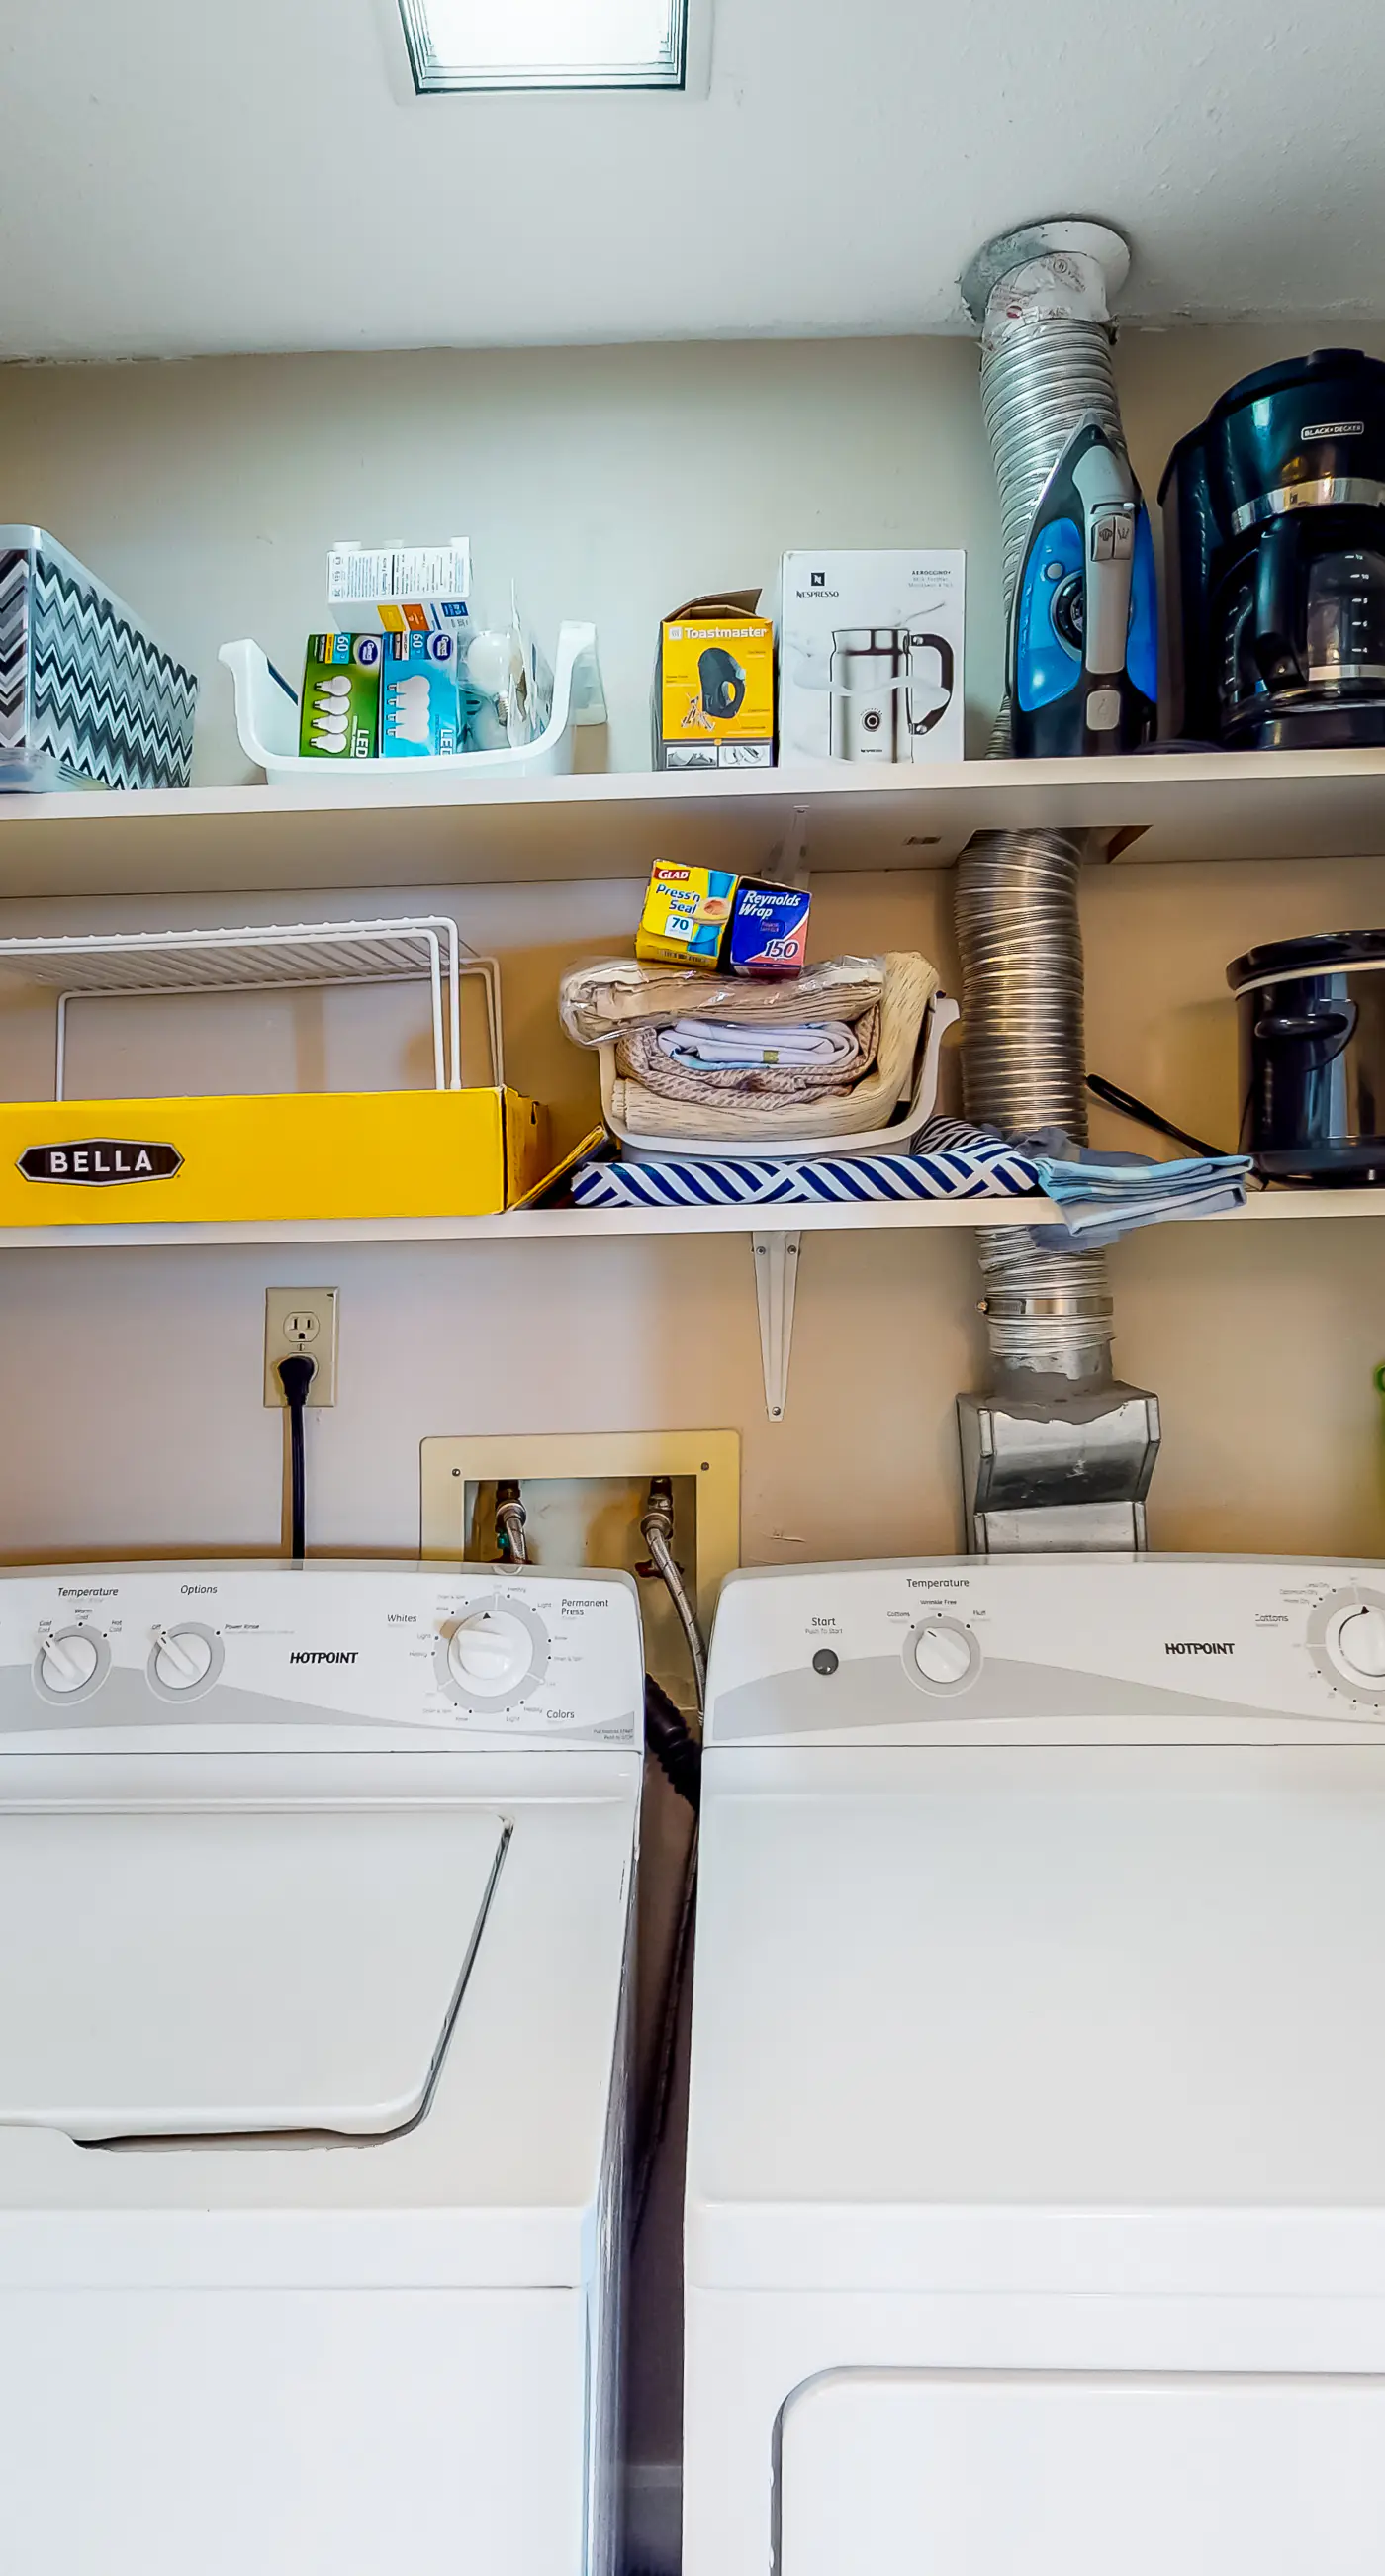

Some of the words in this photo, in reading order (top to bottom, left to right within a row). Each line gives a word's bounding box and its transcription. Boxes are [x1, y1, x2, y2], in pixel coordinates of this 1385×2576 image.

[795, 590, 840, 598] NESPRESSO
[685, 627, 767, 639] Toastmaster
[336, 635, 349, 652] 60
[412, 633, 424, 648] 60
[355, 729, 370, 758] LED
[658, 869, 689, 880] GLAD
[743, 890, 802, 907] Reynolds
[669, 899, 698, 915] Seal
[738, 903, 773, 919] Wrap
[672, 917, 689, 931] 70
[764, 939, 799, 959] 150
[50, 1150, 153, 1173] BELLA
[180, 1584, 218, 1595] Options
[906, 1578, 970, 1589] Temperature
[57, 1587, 119, 1598] Temperature
[811, 1617, 836, 1626] Start
[1164, 1643, 1236, 1655] HOTPOINT
[289, 1652, 359, 1664] HOTPOINT
[546, 1709, 575, 1719] Colors
